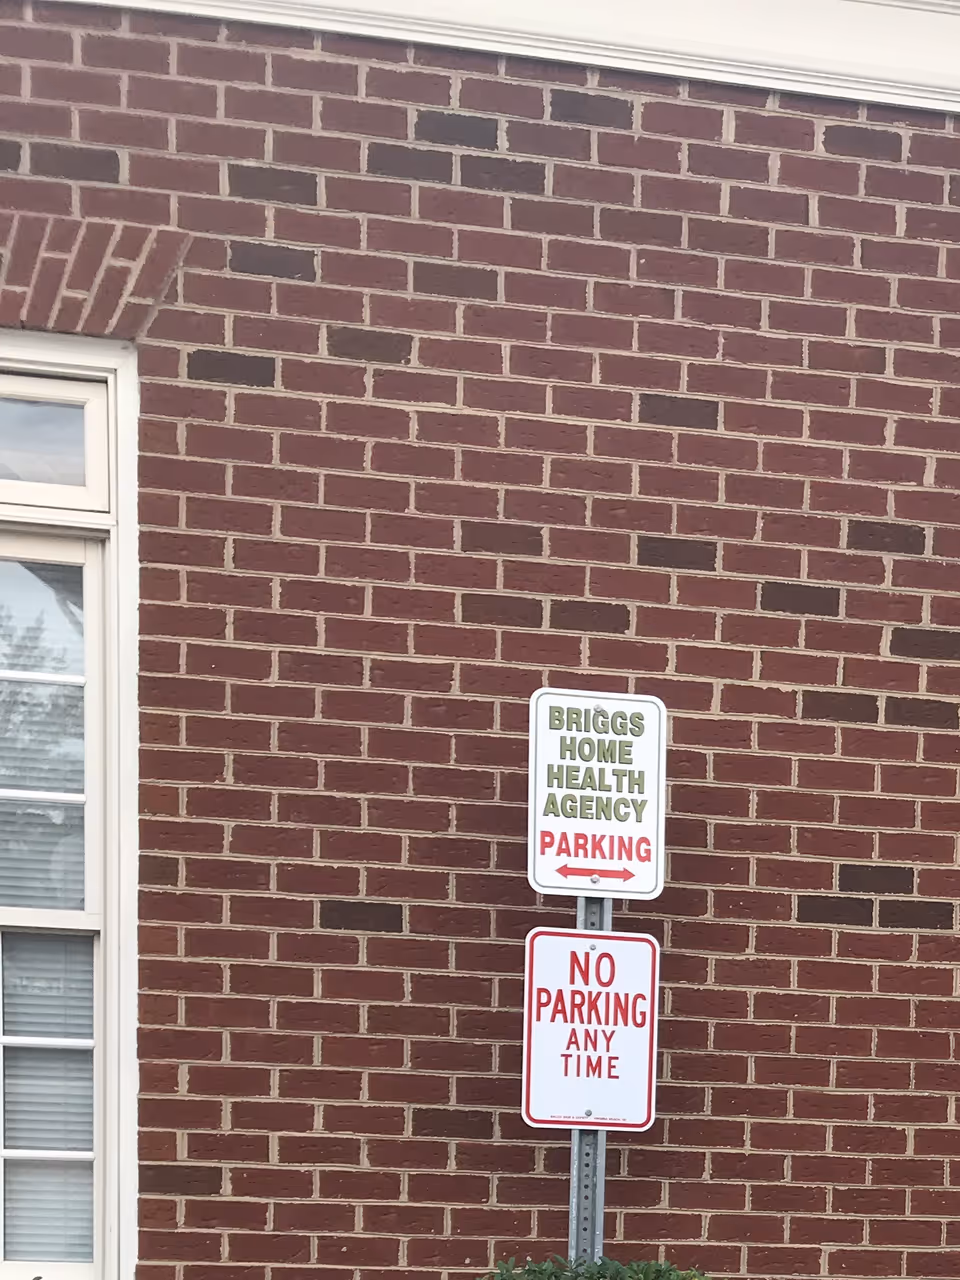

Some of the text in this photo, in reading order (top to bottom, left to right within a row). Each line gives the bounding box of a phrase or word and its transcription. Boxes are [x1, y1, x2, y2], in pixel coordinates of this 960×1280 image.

[549, 705, 645, 737] BRIGGS
[559, 736, 633, 764] HOME
[547, 764, 645, 794] HEALTH
[543, 793, 648, 822] AGENCY
[540, 830, 651, 862] PARKING
[569, 951, 615, 987] NO
[536, 988, 647, 1028] PARKING
[566, 1028, 616, 1052] ANY
[560, 1054, 620, 1079] TIME
